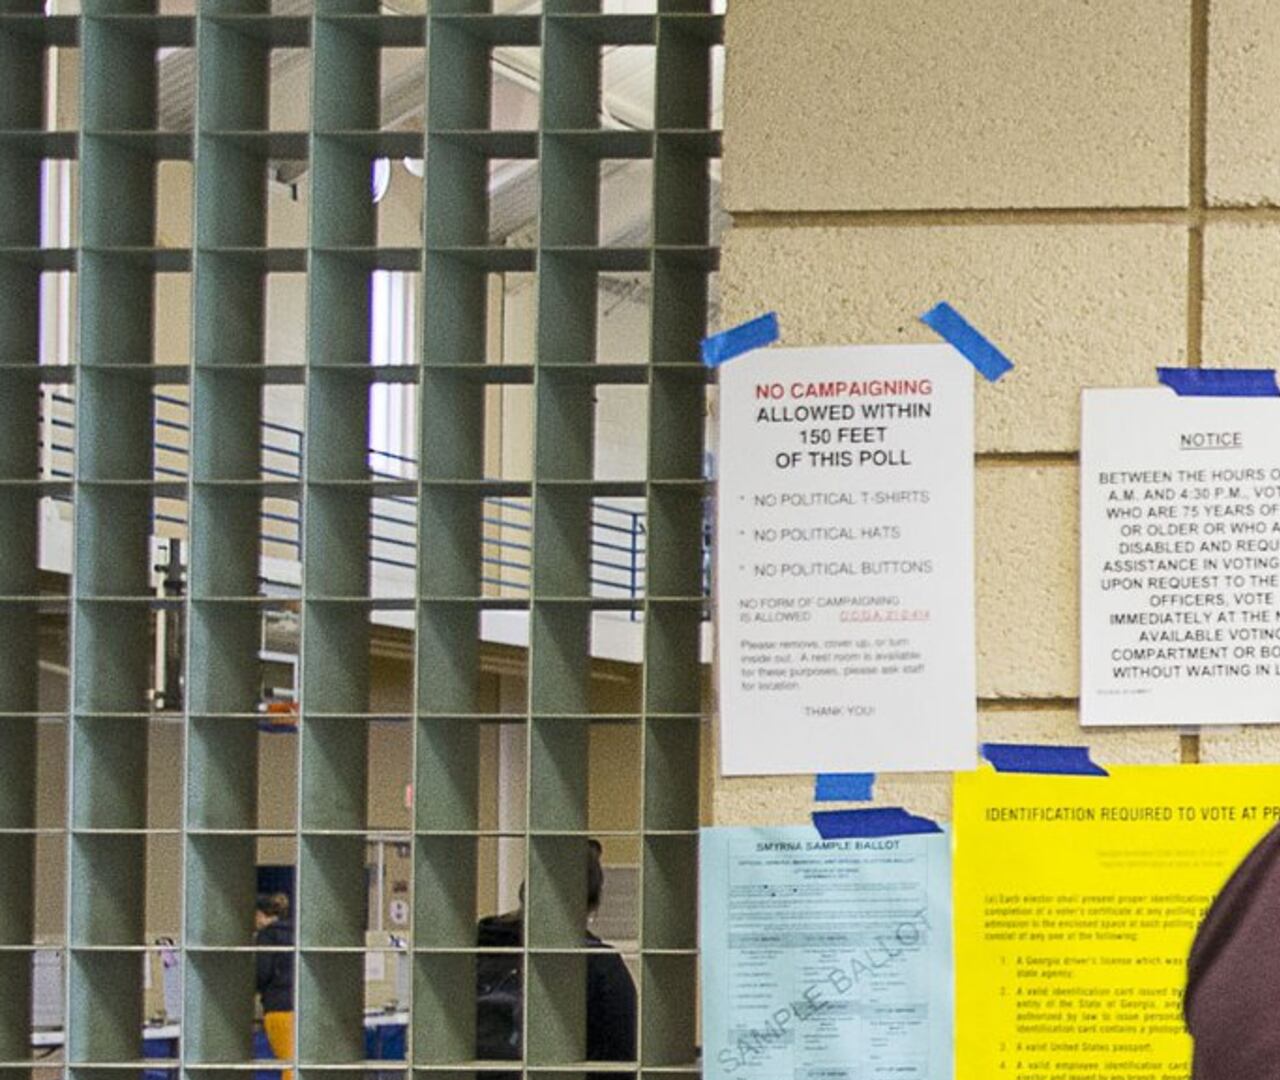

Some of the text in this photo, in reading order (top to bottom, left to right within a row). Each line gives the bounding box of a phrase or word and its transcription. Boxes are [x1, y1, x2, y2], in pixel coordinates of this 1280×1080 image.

[755, 380, 932, 400] NO CAMPAIGNING
[757, 403, 931, 422] ALLOWED WITHIN
[800, 426, 887, 445] 150 FEET
[1180, 432, 1241, 446] NOTICE
[775, 450, 911, 469] OF THIS POLL
[753, 490, 930, 507] NO POLITICAL T-SHIRTS
[1106, 506, 1142, 519] WHO
[1147, 506, 1177, 518] ARE
[1183, 505, 1199, 517] 75
[1204, 504, 1254, 517] YEARS
[1260, 504, 1278, 516] OF
[753, 526, 900, 542] NO POLITICAL HATS
[1120, 524, 1142, 537] OR
[1146, 523, 1199, 536] OLDER
[1203, 522, 1225, 535] OR
[1230, 521, 1267, 534] WHO
[1119, 541, 1195, 554] DISABLED
[1199, 540, 1232, 552] AND
[753, 560, 932, 577] NO POLITICAL BUTTONS
[1103, 559, 1197, 572] ASSISTANCE
[1203, 559, 1218, 569] IN
[1222, 557, 1279, 569] VOTING
[1101, 577, 1143, 591] UPON
[1147, 576, 1218, 589] REQUEST
[1225, 575, 1245, 588] TO
[1249, 574, 1277, 587] THE
[1234, 592, 1272, 605] VOTE
[1110, 612, 1211, 625] IMMEDIATELY
[1217, 611, 1235, 622] AT
[1241, 610, 1268, 622] THE
[1139, 629, 1222, 642] AVAILABLE
[1112, 647, 1228, 661] COMPARTMENT
[1233, 646, 1255, 659] OR
[1113, 665, 1180, 678] WITHOUT
[1186, 664, 1251, 676] WAITING
[1256, 665, 1270, 675] IN
[986, 807, 1095, 821] IDENTIFICATION
[1101, 807, 1172, 821] REQUIRED
[1178, 807, 1195, 821] TO
[1202, 807, 1234, 821] VOTE
[1242, 806, 1257, 819] AT
[756, 840, 899, 852] SMYRNA SAMPLE BALLOT
[716, 985, 829, 1075] SAMPLE
[831, 907, 934, 993] BALLOT
